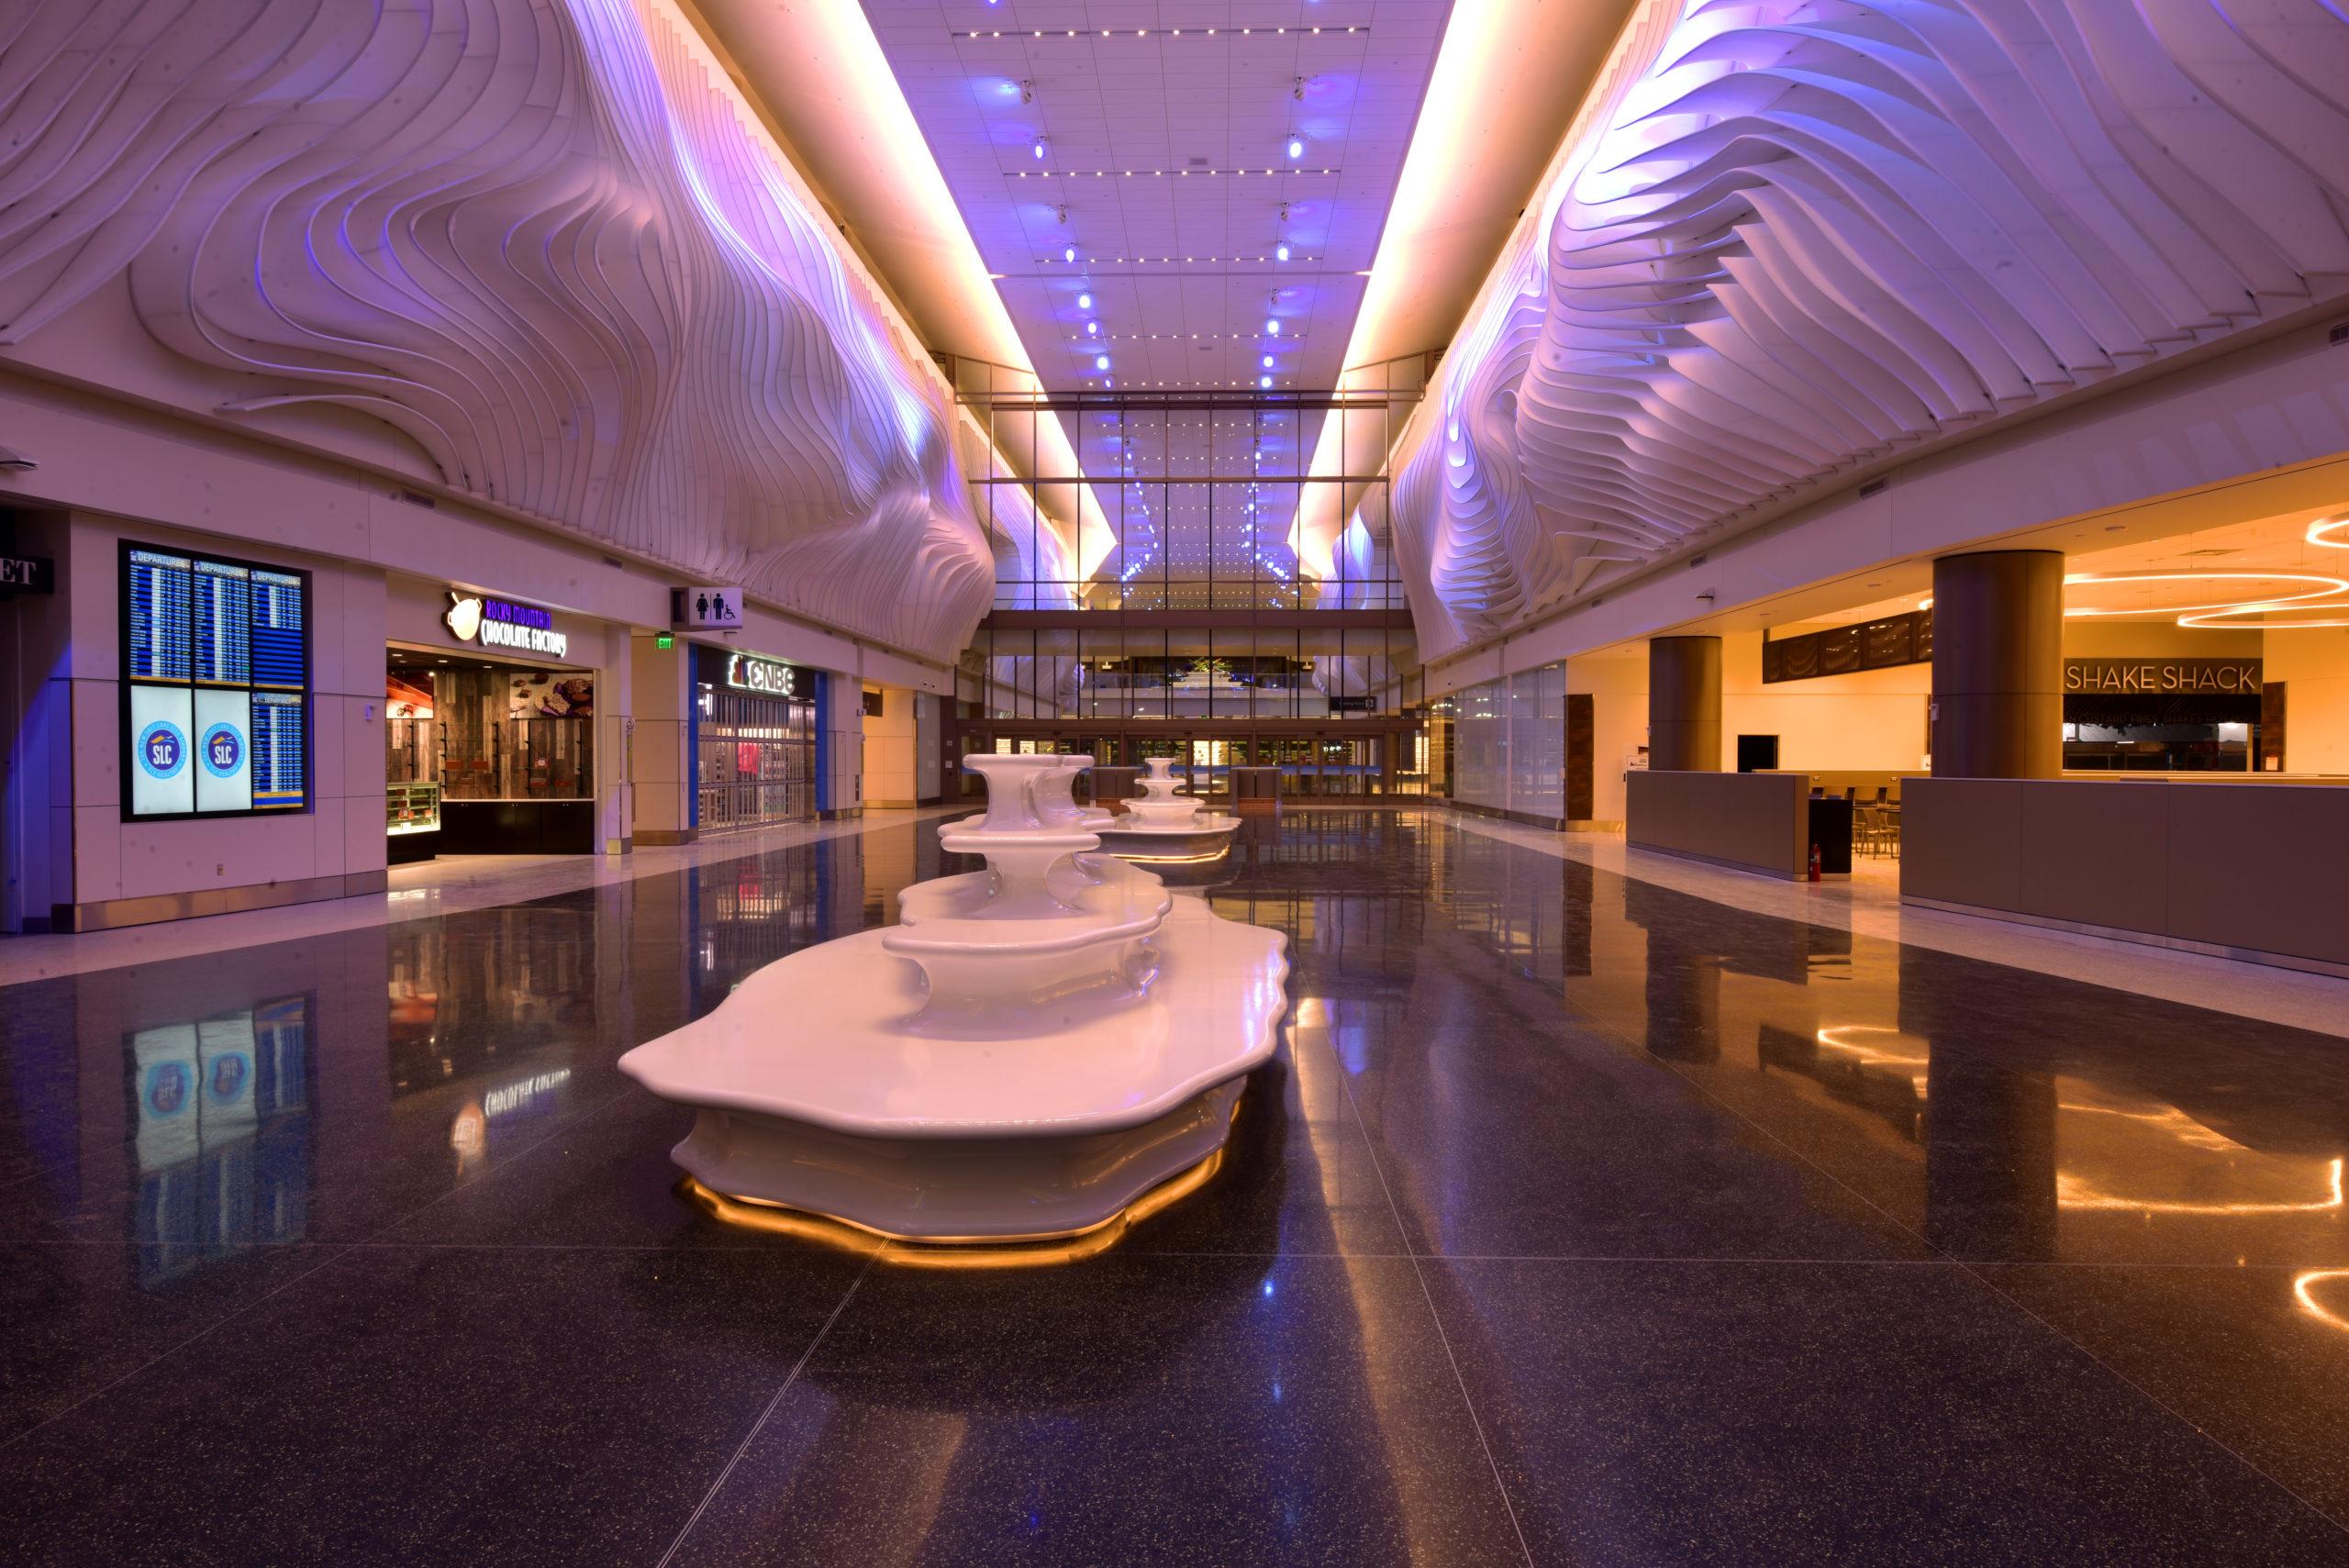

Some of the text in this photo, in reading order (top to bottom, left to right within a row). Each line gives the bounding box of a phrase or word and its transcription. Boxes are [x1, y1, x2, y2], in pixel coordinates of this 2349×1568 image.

[138, 552, 185, 566] DEPARTURES
[0, 558, 37, 584] ET
[201, 562, 243, 577] DEPARTURES
[257, 573, 297, 584] DEPARTURES
[486, 599, 551, 631] ROCKY MOUNTAIN
[481, 618, 566, 658] CHOCOLATE FACTORY
[658, 638, 672, 649] EXIT
[750, 662, 796, 694] CNBC
[2065, 665, 2256, 689] SHAKE SHACK
[152, 745, 173, 764] SLC
[215, 745, 232, 764] SLC
